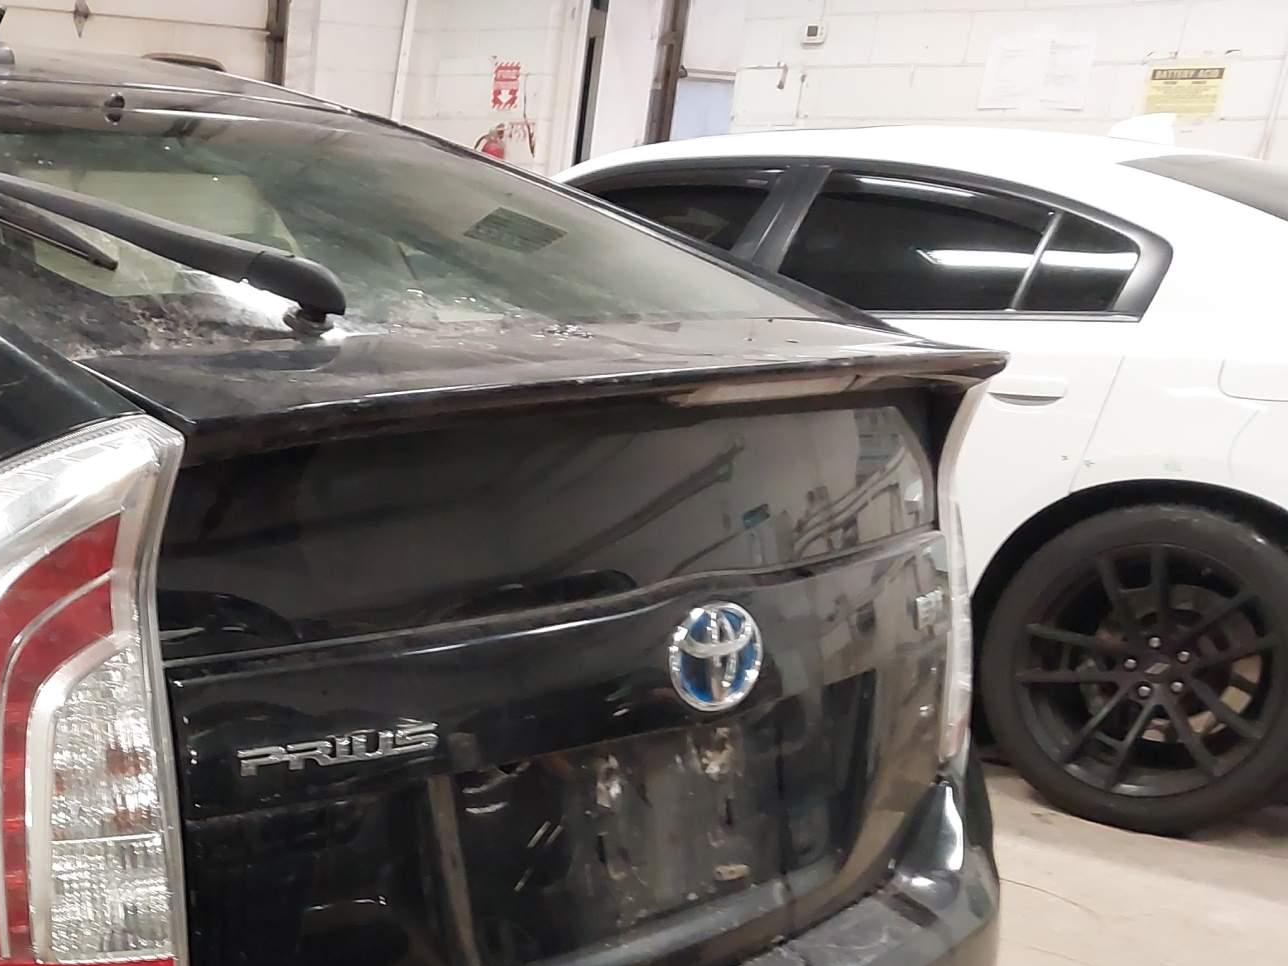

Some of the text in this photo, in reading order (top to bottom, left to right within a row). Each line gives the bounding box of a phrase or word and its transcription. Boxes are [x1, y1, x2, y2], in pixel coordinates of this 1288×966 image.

[1154, 68, 1220, 79] BATTERY ACID
[237, 721, 440, 776] PRIUS
